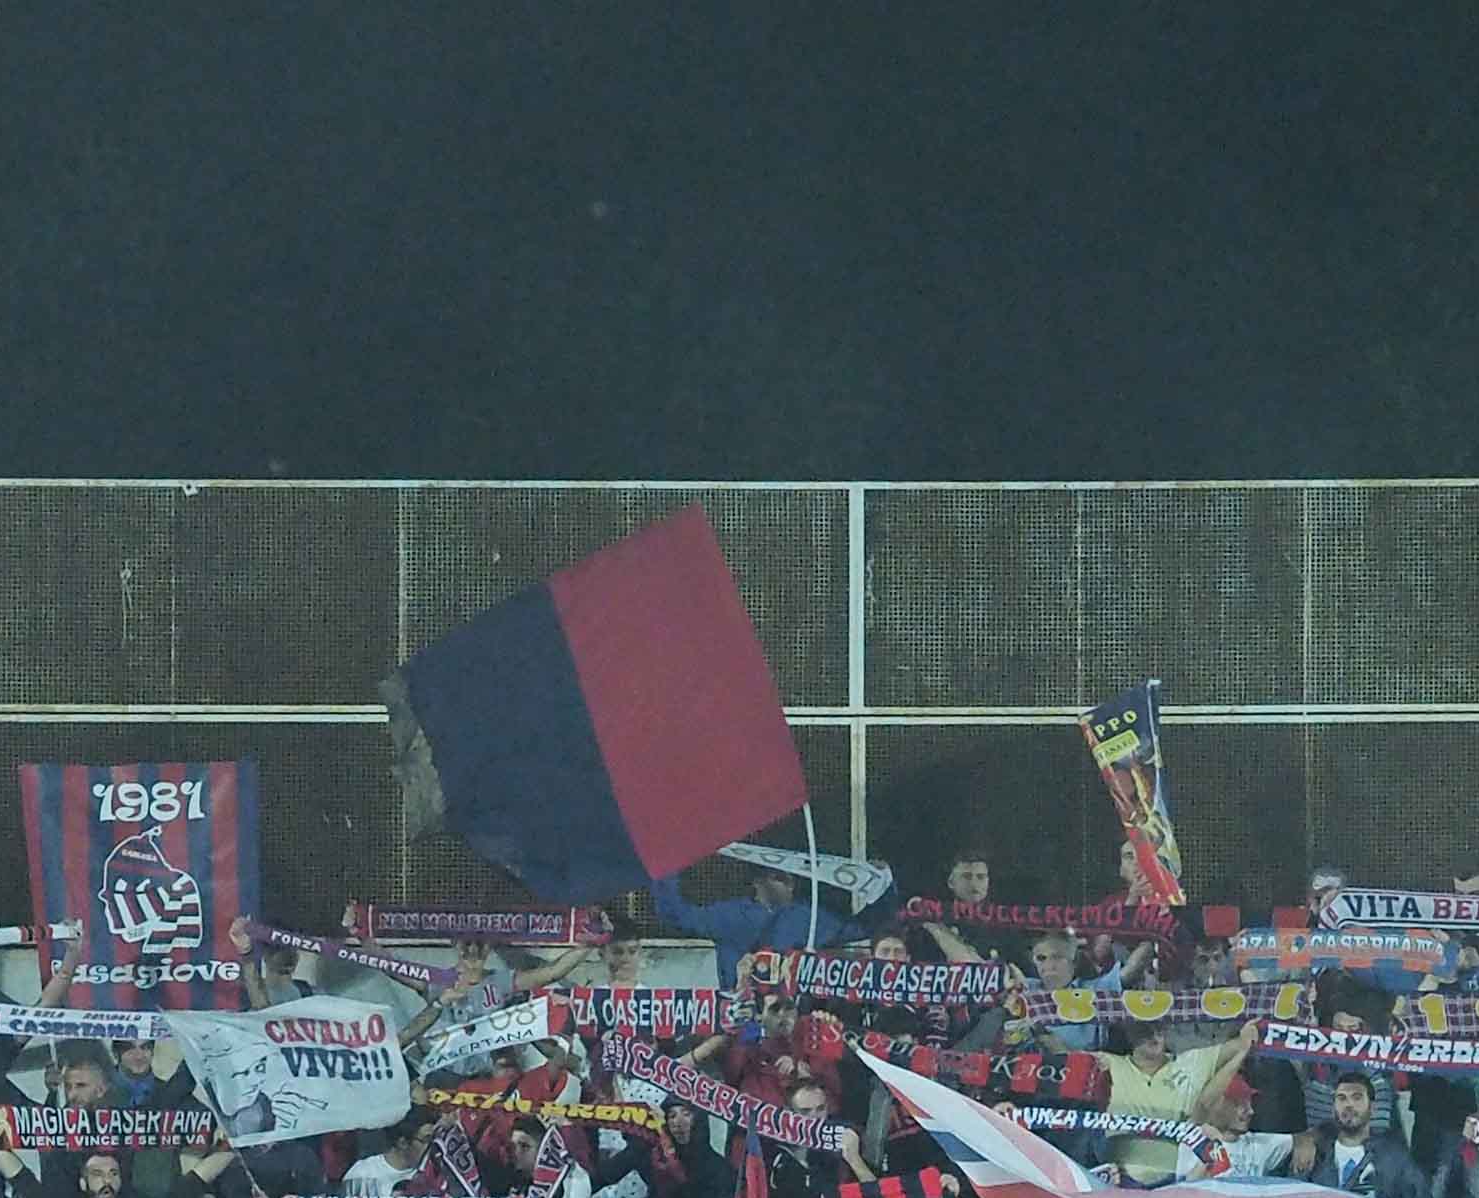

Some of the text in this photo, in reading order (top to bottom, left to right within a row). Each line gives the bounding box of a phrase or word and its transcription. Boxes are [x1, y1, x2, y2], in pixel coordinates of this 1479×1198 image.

[93, 781, 205, 821] 1981
[1342, 895, 1423, 918] VITA
[796, 955, 999, 993] MAGICA CASERTANA
[9, 1019, 139, 1039] CASERTANA
[602, 999, 711, 1026] CASERTANA
[265, 1014, 386, 1048] CAVALLO
[1264, 1024, 1394, 1058] FEDAYN
[281, 1047, 393, 1081] VIVE!!!
[426, 1030, 535, 1069] CASERTANA
[632, 1042, 816, 1147] CASERTANI
[14, 1105, 212, 1135] MAGICA CASERTANA
[21, 1136, 71, 1148] VIENE,
[75, 1136, 120, 1147] VINCE
[186, 1136, 206, 1146] VA
